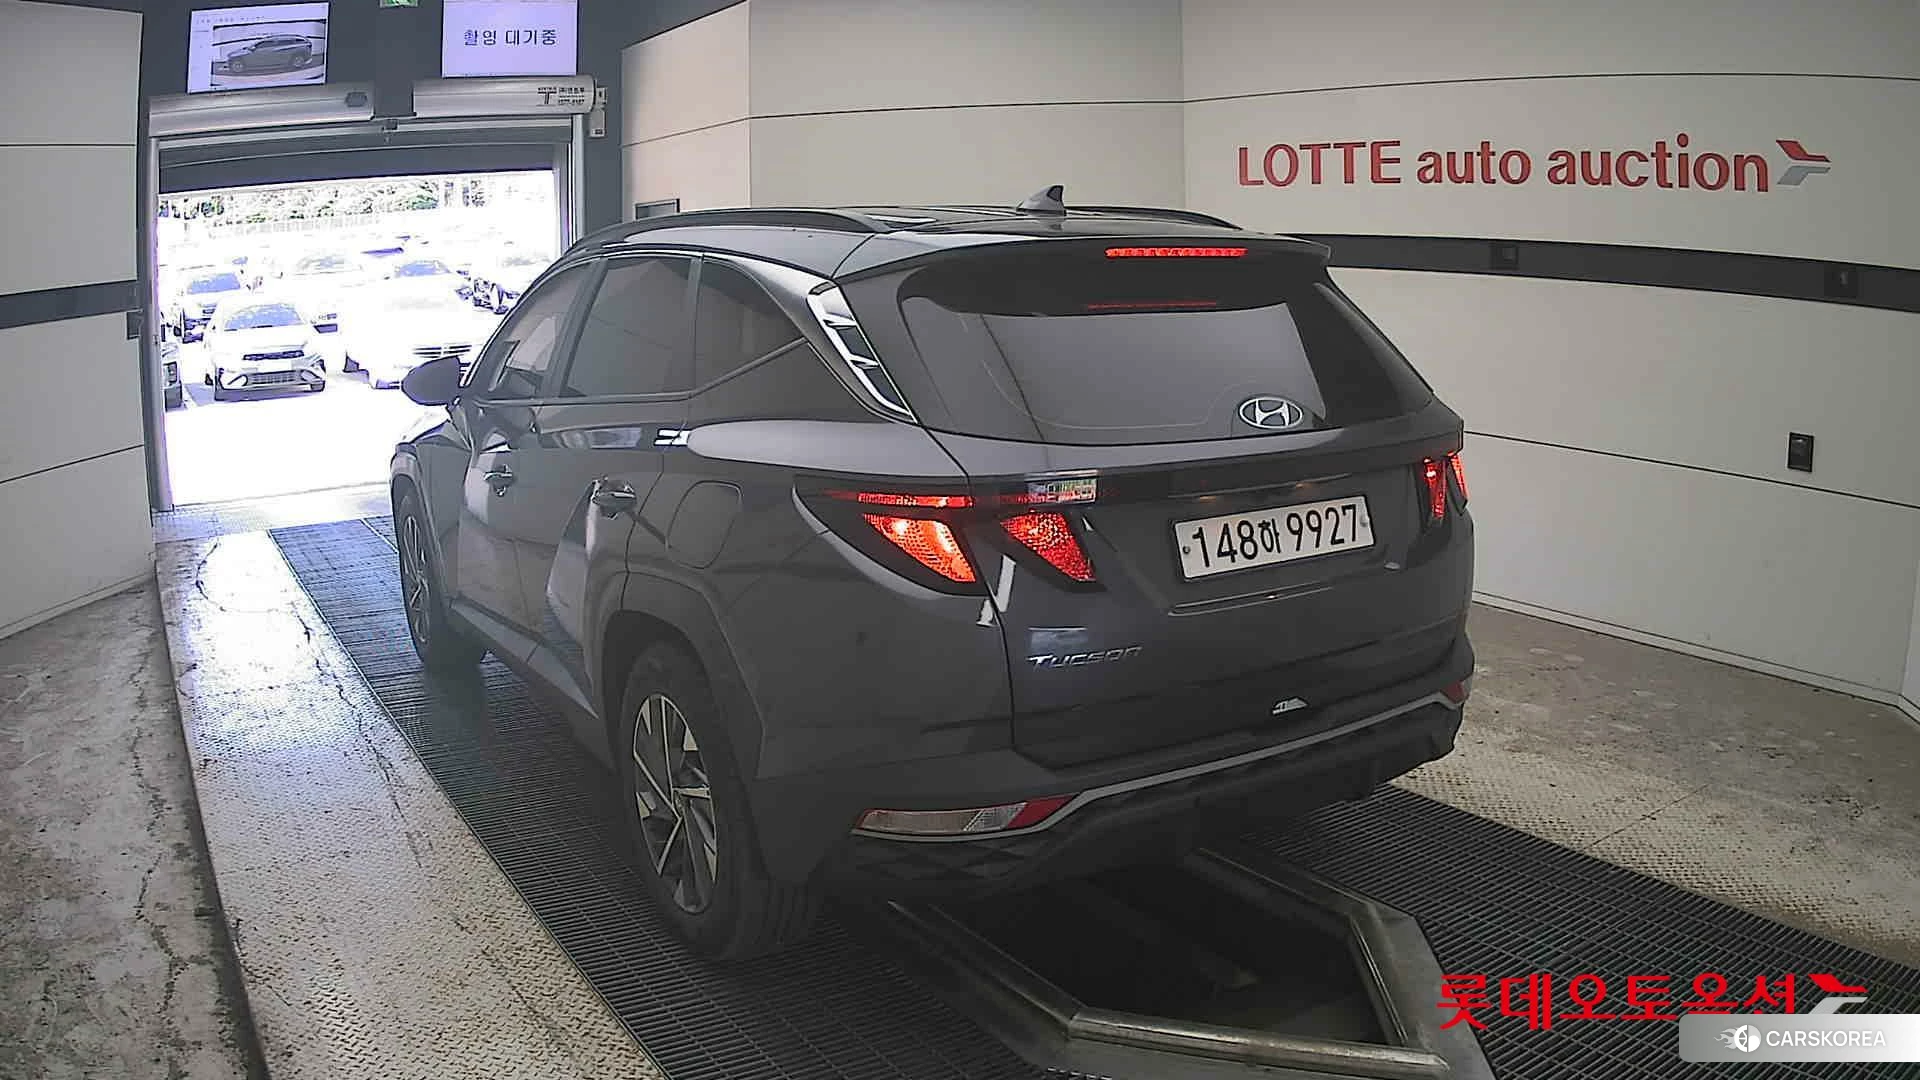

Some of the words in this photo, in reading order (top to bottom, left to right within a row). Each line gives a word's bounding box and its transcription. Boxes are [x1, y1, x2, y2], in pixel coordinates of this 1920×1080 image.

[505, 29, 557, 46] 대기중
[1238, 140, 1401, 187] LOTTE
[1416, 140, 1532, 186] auto
[1547, 133, 1769, 193] auction
